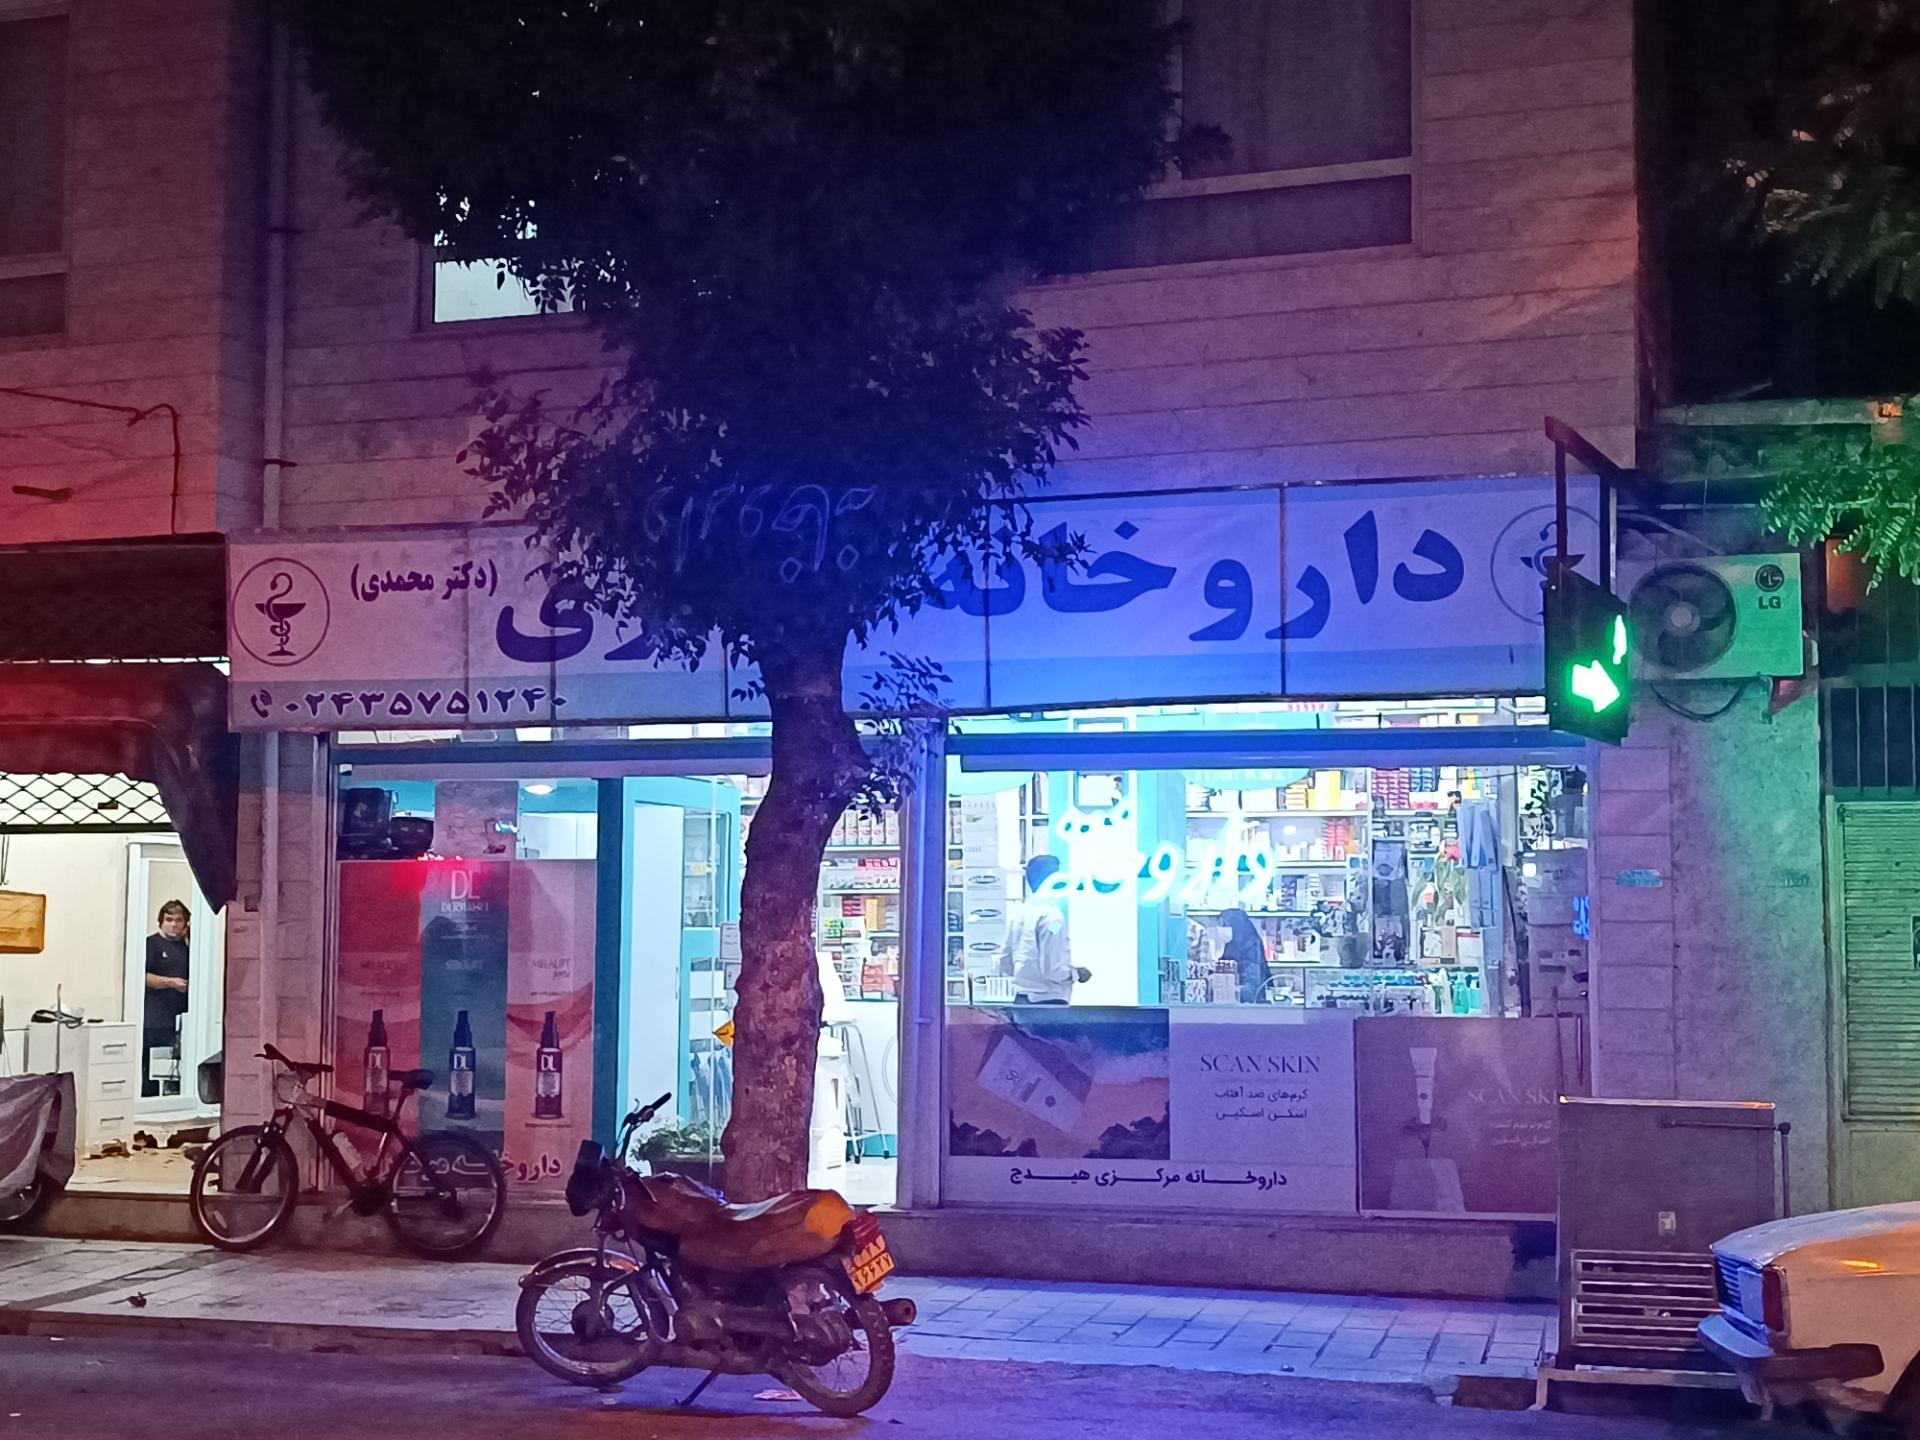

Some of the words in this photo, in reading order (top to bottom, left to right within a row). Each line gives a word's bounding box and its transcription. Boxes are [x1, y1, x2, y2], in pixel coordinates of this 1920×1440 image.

[350, 562, 435, 602] محمدی)
[441, 557, 498, 600] (دکتر
[1758, 595, 1782, 610] LG
[450, 869, 481, 900] DL
[540, 1054, 557, 1071] DL
[1200, 1054, 1262, 1073] SCAN
[1267, 1054, 1320, 1073] SKIN
[1009, 1166, 1091, 1185] هیدج
[1094, 1167, 1181, 1188] مرکزی
[1184, 1168, 1288, 1191] داروخانه
